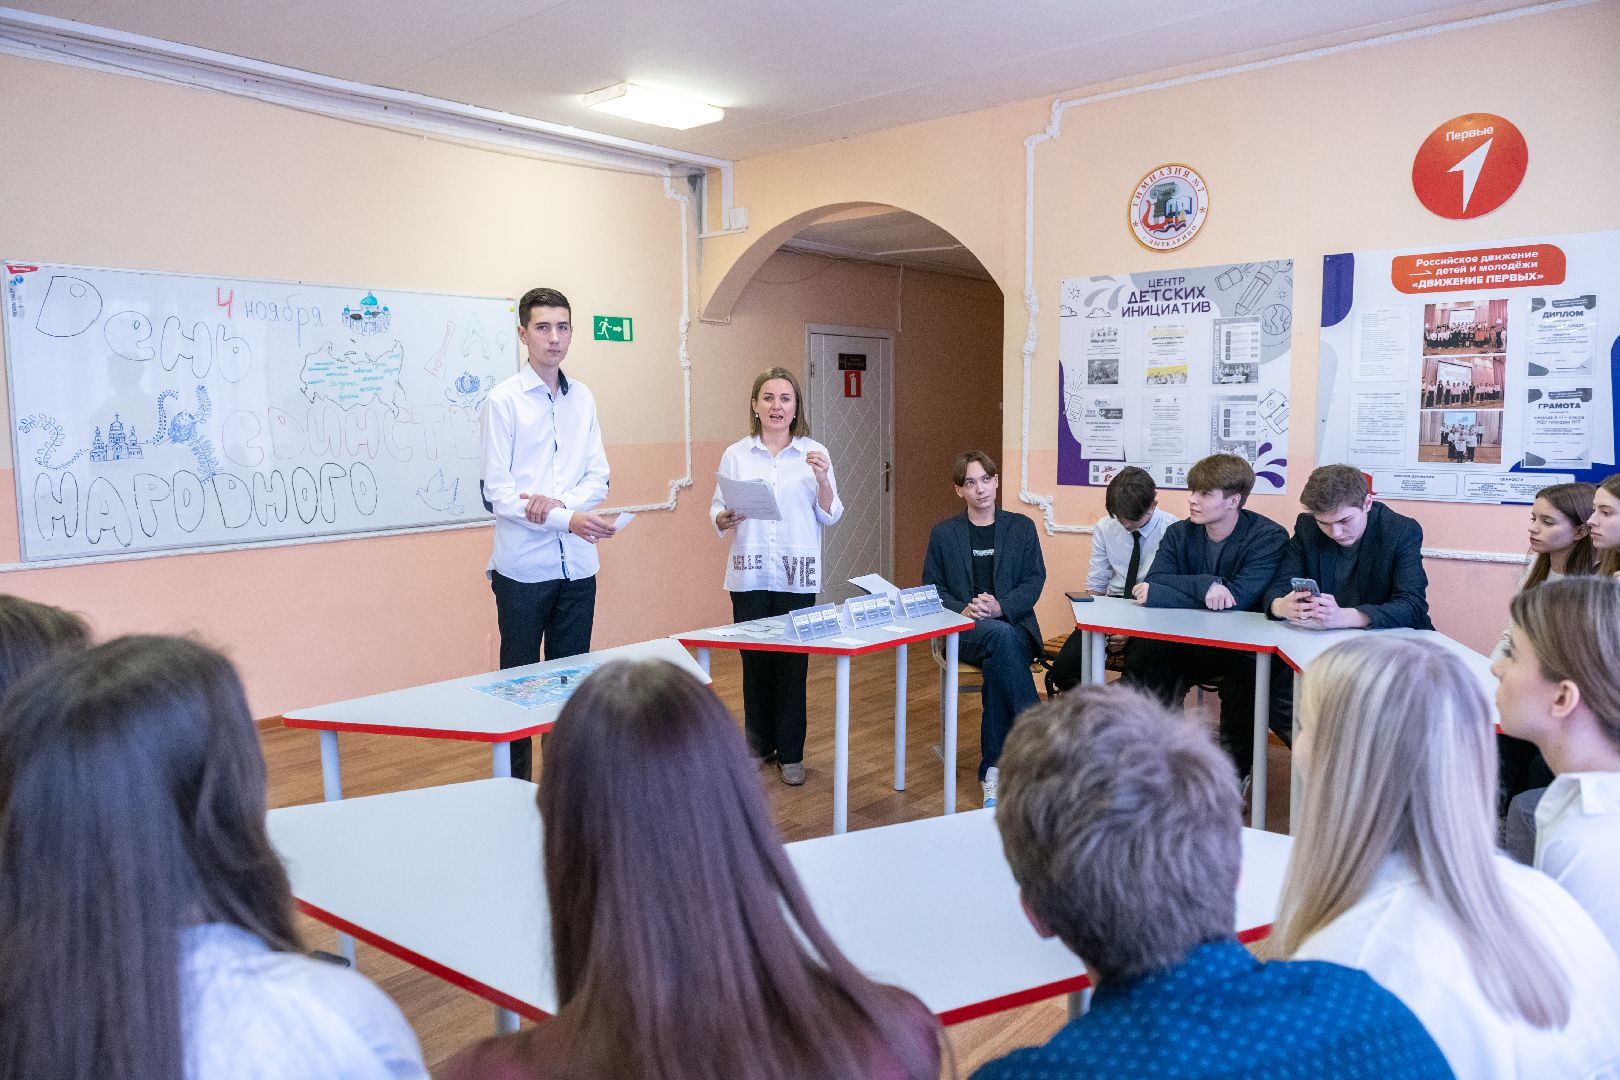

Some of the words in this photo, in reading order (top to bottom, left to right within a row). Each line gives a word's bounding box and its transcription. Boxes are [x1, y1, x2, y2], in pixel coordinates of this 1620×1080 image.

[1445, 126, 1494, 142] Первые
[1415, 256, 1479, 268] Российское
[1481, 251, 1538, 263] движение
[1435, 266, 1467, 276] детей
[1469, 264, 1477, 273] и
[1478, 261, 1538, 273] молодёжи
[1148, 276, 1186, 289] ЦЕНТР
[1411, 278, 1484, 290] «ДВИЖЕНИЕ
[1485, 272, 1545, 284] ПЕРВЫХ»
[1127, 285, 1206, 305] ДЕТСКИХ
[1121, 300, 1211, 318] ИНИЦИАТИВ
[1542, 310, 1584, 319] ДИПЛОМ
[243, 292, 326, 348] ноября
[34, 462, 378, 547] НАРОДНОГО
[781, 555, 817, 587] VIE
